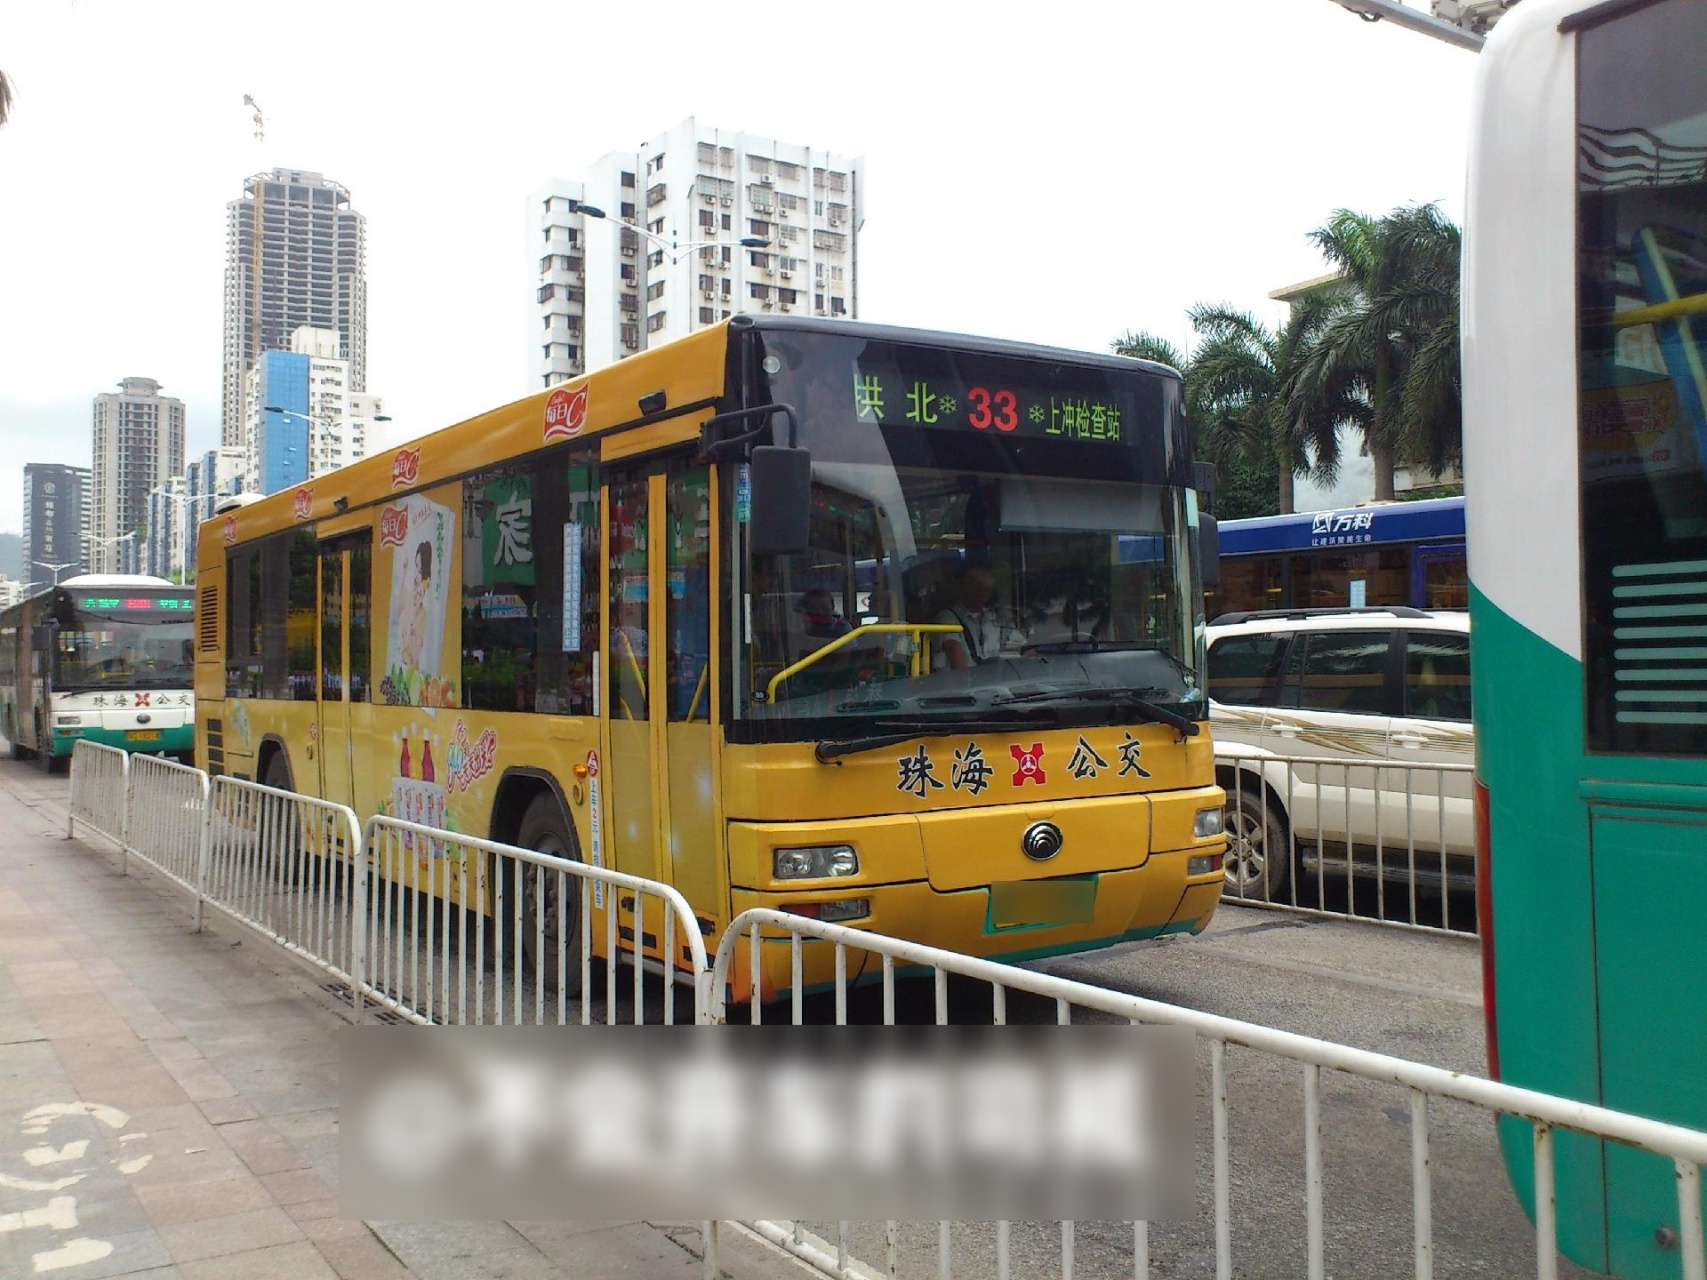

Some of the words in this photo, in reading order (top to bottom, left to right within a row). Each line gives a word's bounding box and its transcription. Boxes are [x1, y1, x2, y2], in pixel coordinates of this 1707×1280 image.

[968, 386, 1018, 431] 33
[1045, 396, 1120, 441] 上冲检查站
[1332, 512, 1374, 533] 万科
[93, 694, 128, 707] 珠海
[156, 693, 191, 706] 公交
[897, 741, 995, 798] 珠海
[1067, 731, 1151, 779] 公交
